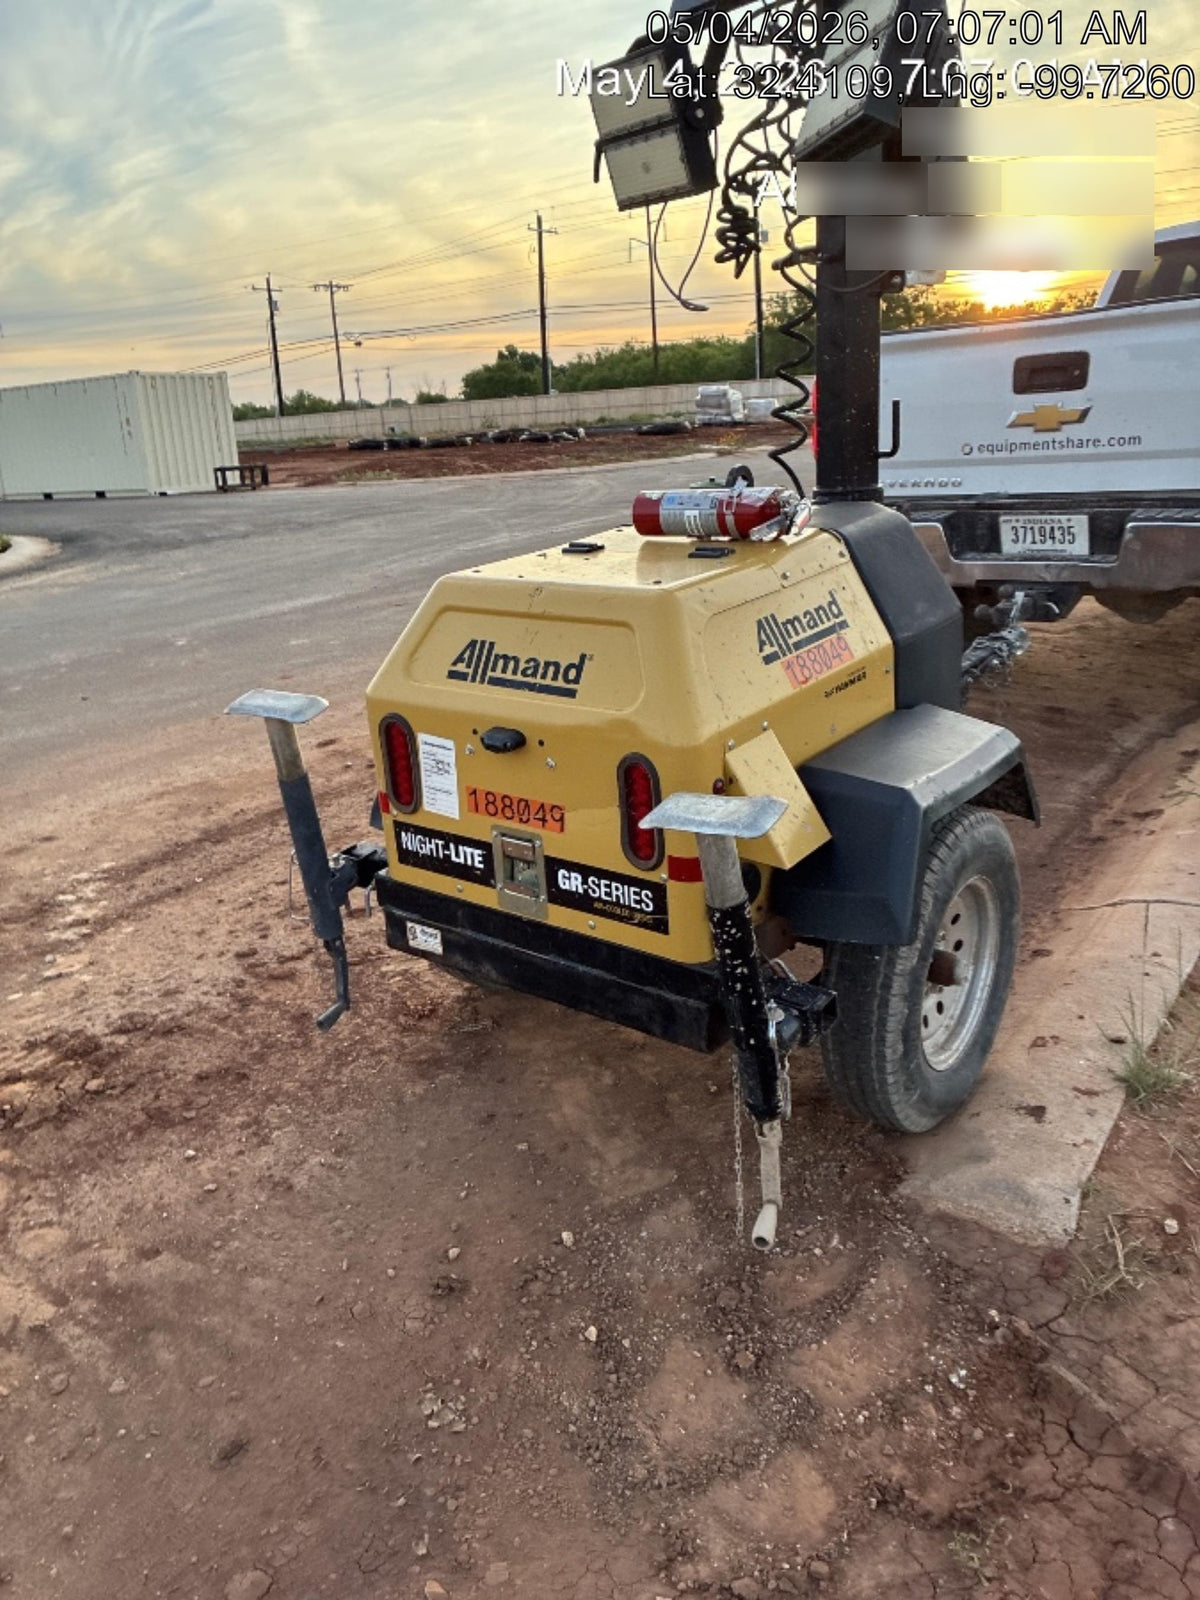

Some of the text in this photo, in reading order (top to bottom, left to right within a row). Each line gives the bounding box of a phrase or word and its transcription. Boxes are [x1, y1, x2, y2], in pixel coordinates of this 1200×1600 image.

[977, 434, 1143, 456] equipmentshare.com
[1010, 525, 1077, 546] 3719435
[756, 588, 845, 655] Allmand
[450, 639, 588, 685] Allmand
[469, 788, 564, 832] 188049
[401, 831, 484, 869] NIGHT-LITE
[557, 868, 654, 912] GR-SERIES
